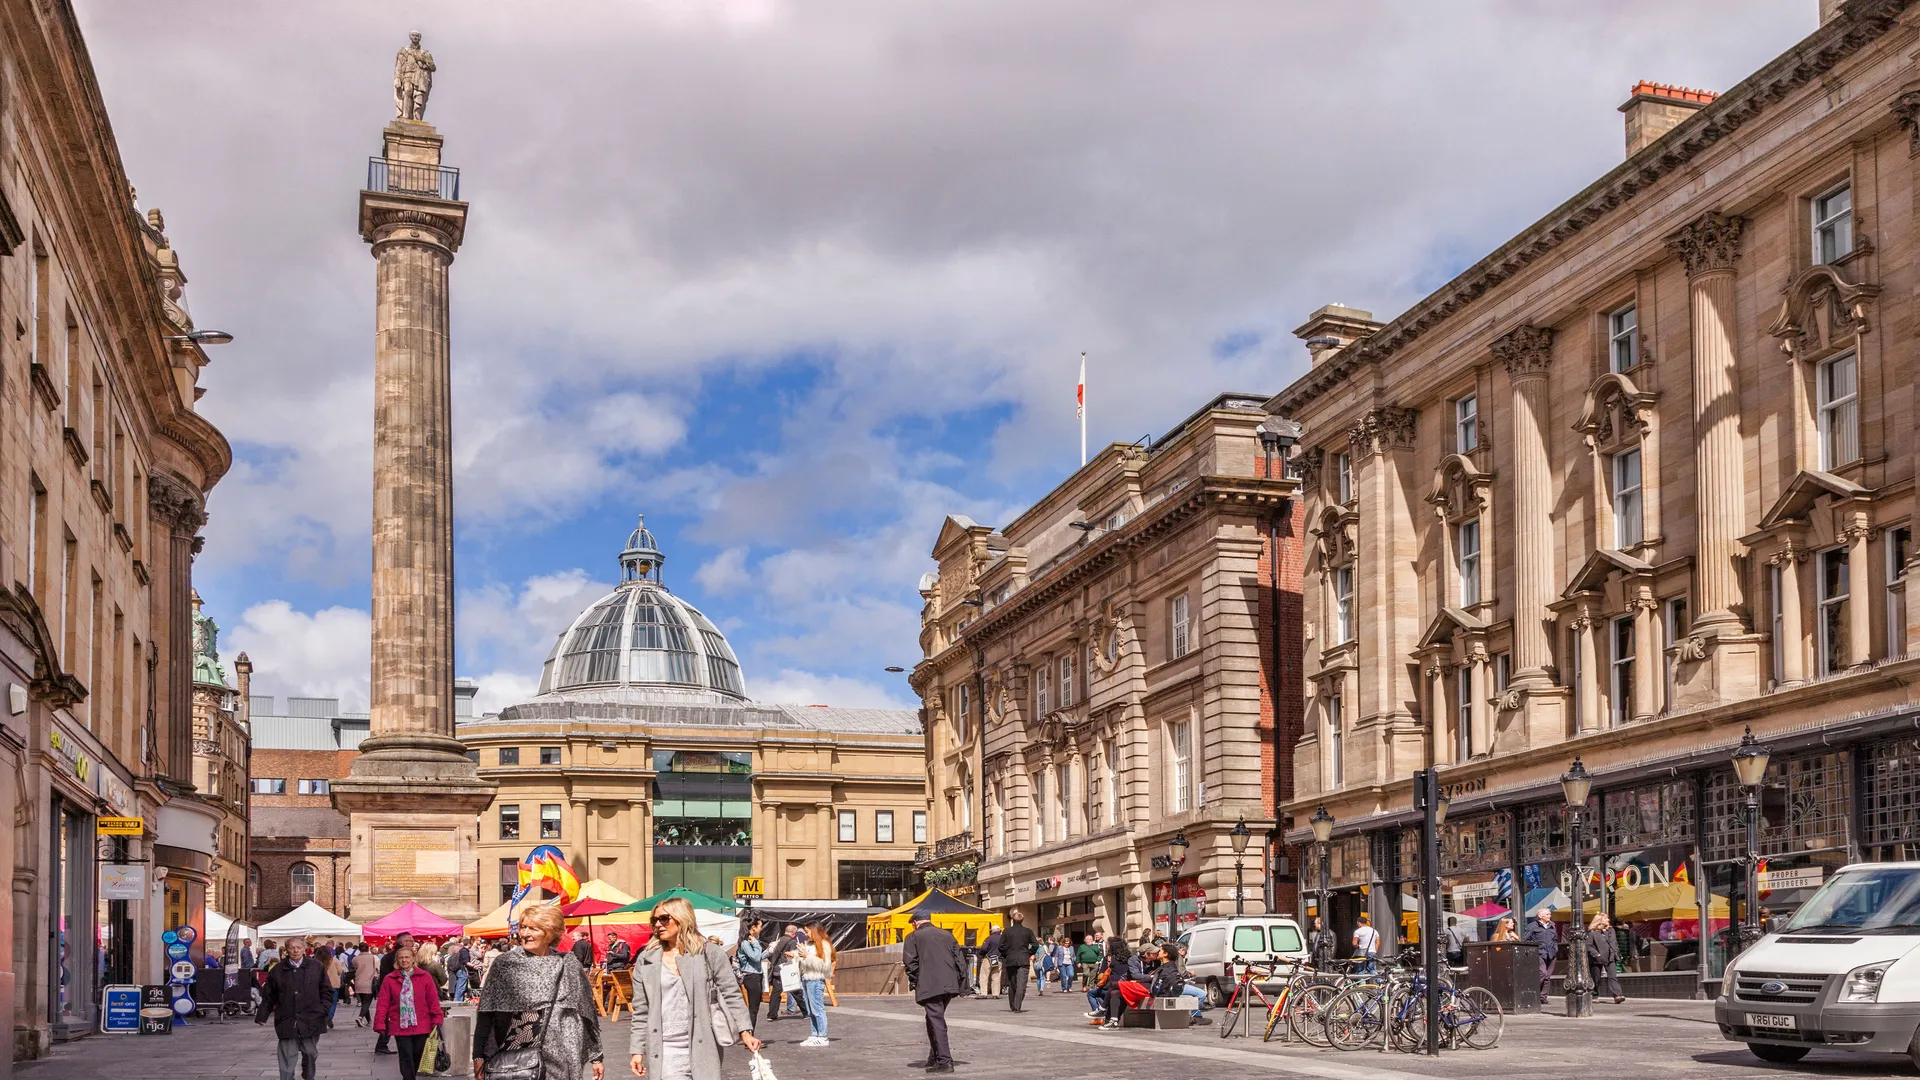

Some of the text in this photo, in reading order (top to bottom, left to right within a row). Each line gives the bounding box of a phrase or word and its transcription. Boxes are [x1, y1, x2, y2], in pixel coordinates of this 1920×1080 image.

[1560, 861, 1670, 896] BYRON
[1772, 870, 1798, 878] PROPER
[743, 880, 759, 892] M
[1762, 879, 1808, 890] HAMBURGERS
[1752, 1014, 1790, 1027] YR61 GUC
